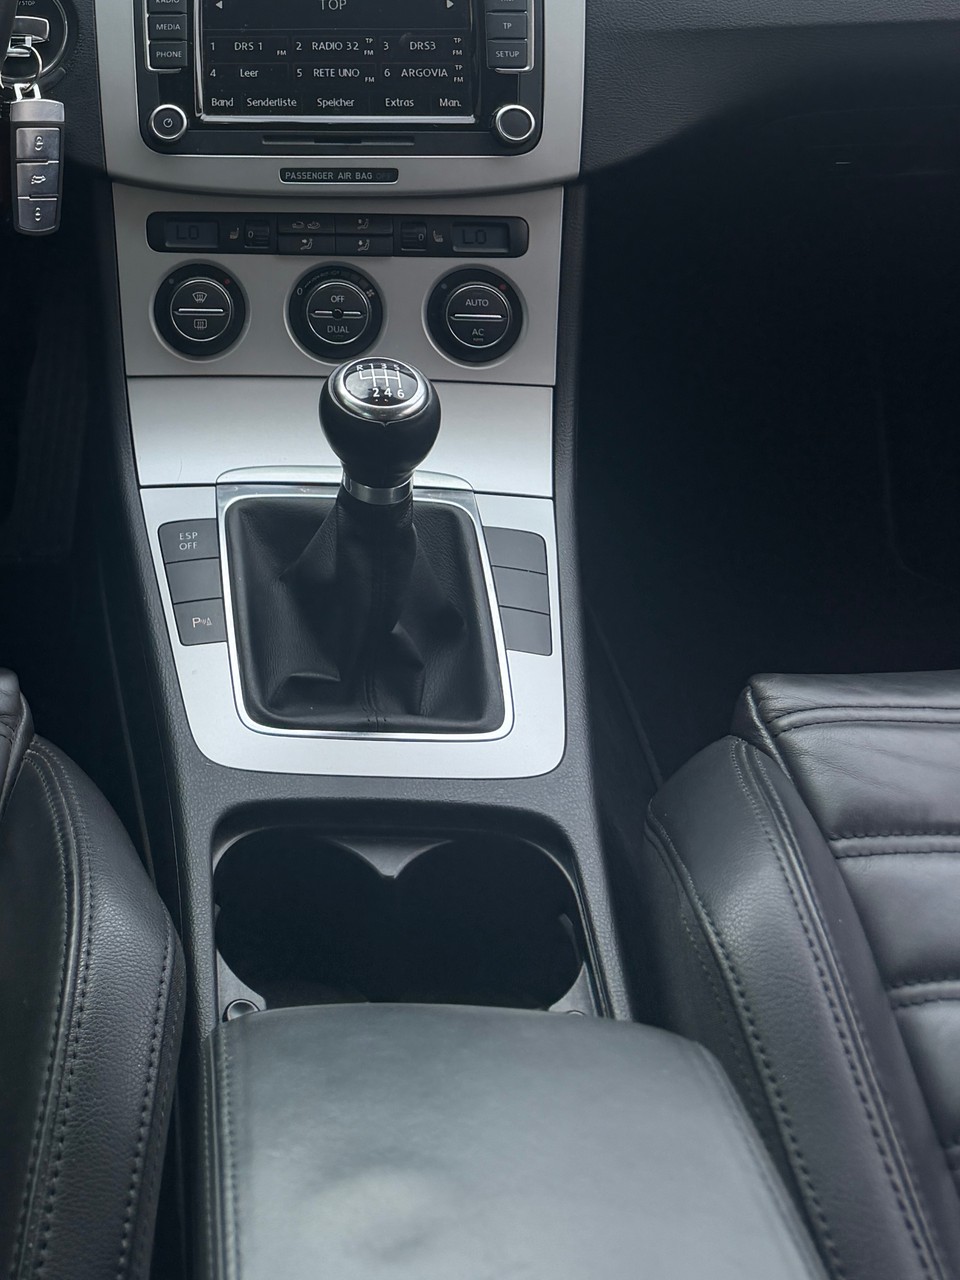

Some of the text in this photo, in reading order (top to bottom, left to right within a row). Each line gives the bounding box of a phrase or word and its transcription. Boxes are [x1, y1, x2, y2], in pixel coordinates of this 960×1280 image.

[156, 23, 181, 31] MEDIA
[210, 42, 216, 51] 1
[234, 42, 254, 51] DRS
[257, 42, 263, 51] 1
[296, 42, 302, 51] 2
[312, 42, 343, 51] RADIO
[346, 42, 359, 51] 32
[383, 42, 389, 51] 3
[410, 42, 436, 51] DRS3
[156, 50, 182, 58] PHONE
[495, 50, 520, 58] SETUP
[209, 68, 259, 77] 4 Leer
[296, 69, 303, 77] 5
[313, 68, 335, 77] RETE
[338, 68, 360, 77] UNO
[384, 69, 391, 77] 6
[401, 68, 448, 78] ARGOVIA
[211, 97, 234, 108] Band
[246, 97, 297, 108] Senderliste
[316, 97, 355, 108] Speicher
[385, 97, 415, 108] Extras
[439, 98, 462, 107] Man.
[285, 171, 334, 180] PASSENGER
[337, 171, 352, 180] AIR
[355, 171, 373, 180] BAG
[330, 294, 345, 303] OFF
[465, 298, 489, 307] AUTO
[327, 325, 350, 333] DUAL
[471, 328, 485, 336] AC
[372, 387, 405, 398] 2 4 6
[179, 531, 198, 540] ESP
[179, 541, 198, 551] OFF
